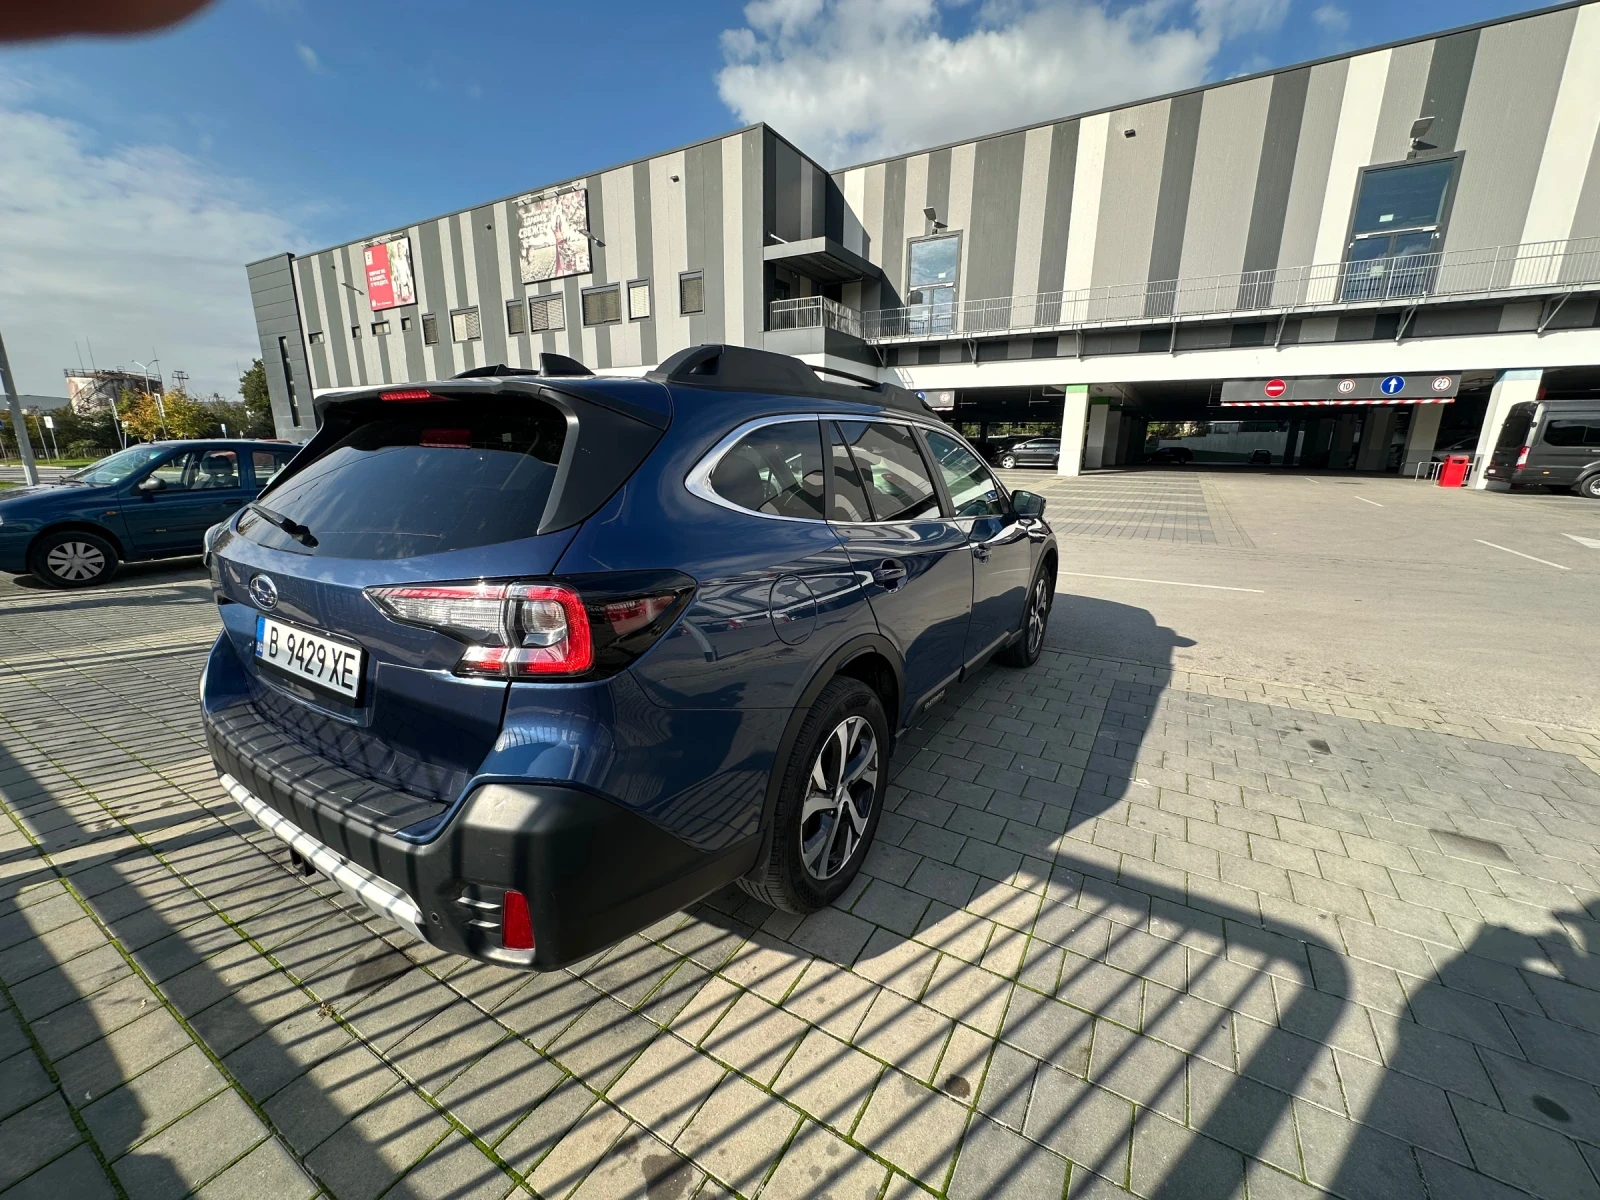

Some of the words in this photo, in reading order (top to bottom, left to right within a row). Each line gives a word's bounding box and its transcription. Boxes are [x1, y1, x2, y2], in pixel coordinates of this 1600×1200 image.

[1342, 382, 1351, 390] 10
[269, 626, 279, 658] B
[287, 633, 326, 678] 9429
[328, 647, 356, 691] XE
